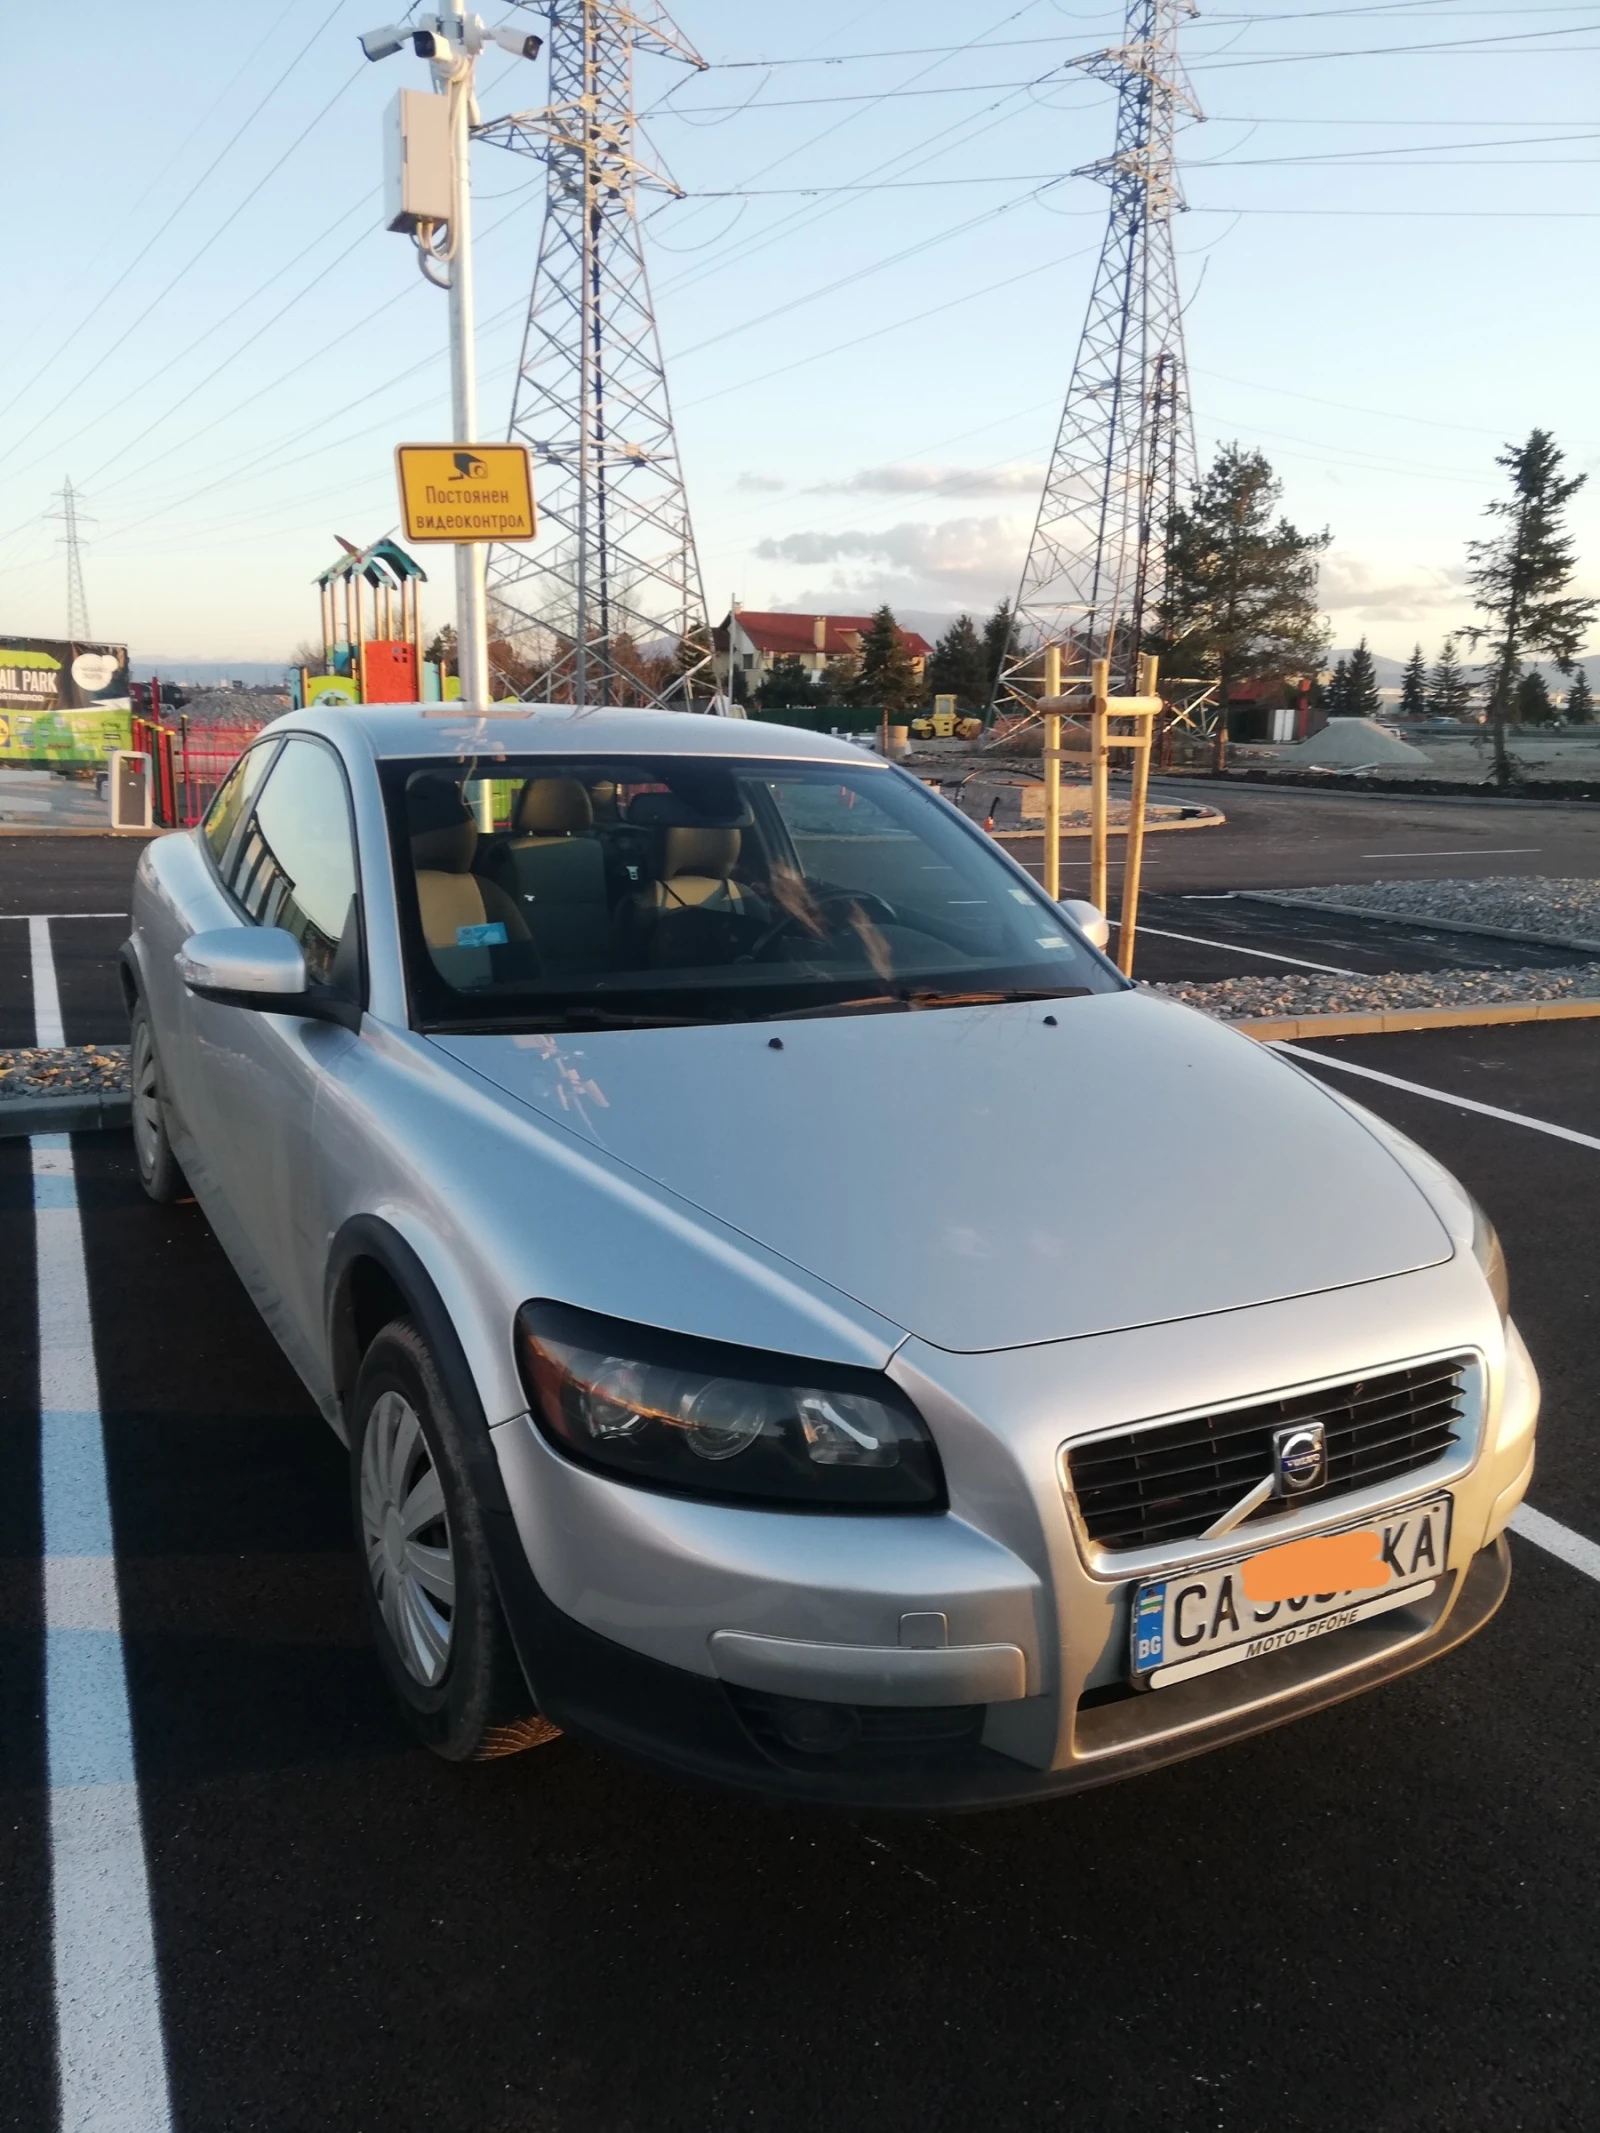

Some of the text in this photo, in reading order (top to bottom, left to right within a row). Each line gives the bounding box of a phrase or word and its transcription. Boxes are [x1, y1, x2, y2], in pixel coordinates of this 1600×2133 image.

[426, 486, 509, 503] Постоянен
[416, 515, 525, 532] видеоконтрол
[22, 670, 58, 693] PARK
[1284, 1453, 1320, 1467] VOLVO
[1174, 1574, 1240, 1647] CA
[1382, 1513, 1436, 1578] KA
[1246, 1610, 1360, 1658] MOTO-PFOHE
[1138, 1635, 1161, 1659] BG
